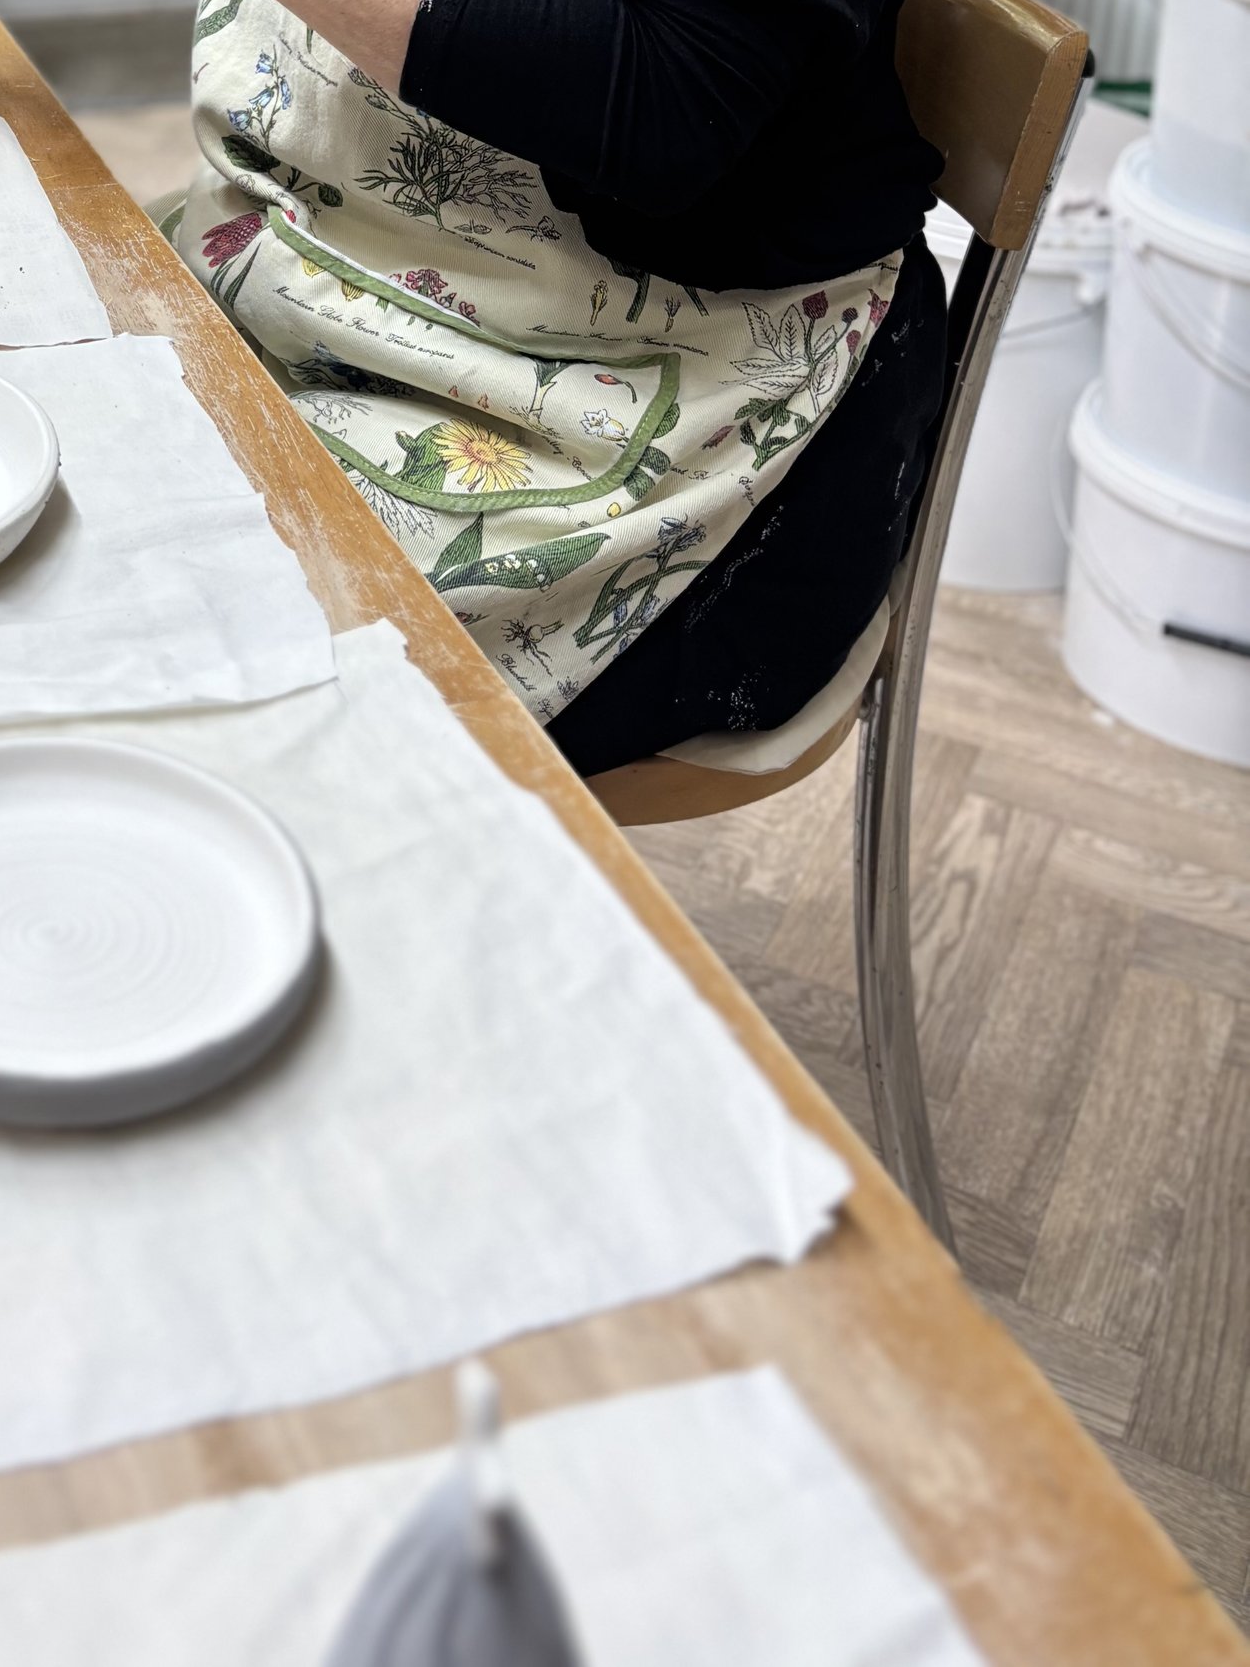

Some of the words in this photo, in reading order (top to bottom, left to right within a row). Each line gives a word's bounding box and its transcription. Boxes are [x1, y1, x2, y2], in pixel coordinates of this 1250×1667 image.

[273, 286, 315, 312] Mountain
[317, 305, 343, 324] Globe
[346, 316, 380, 337] Flower
